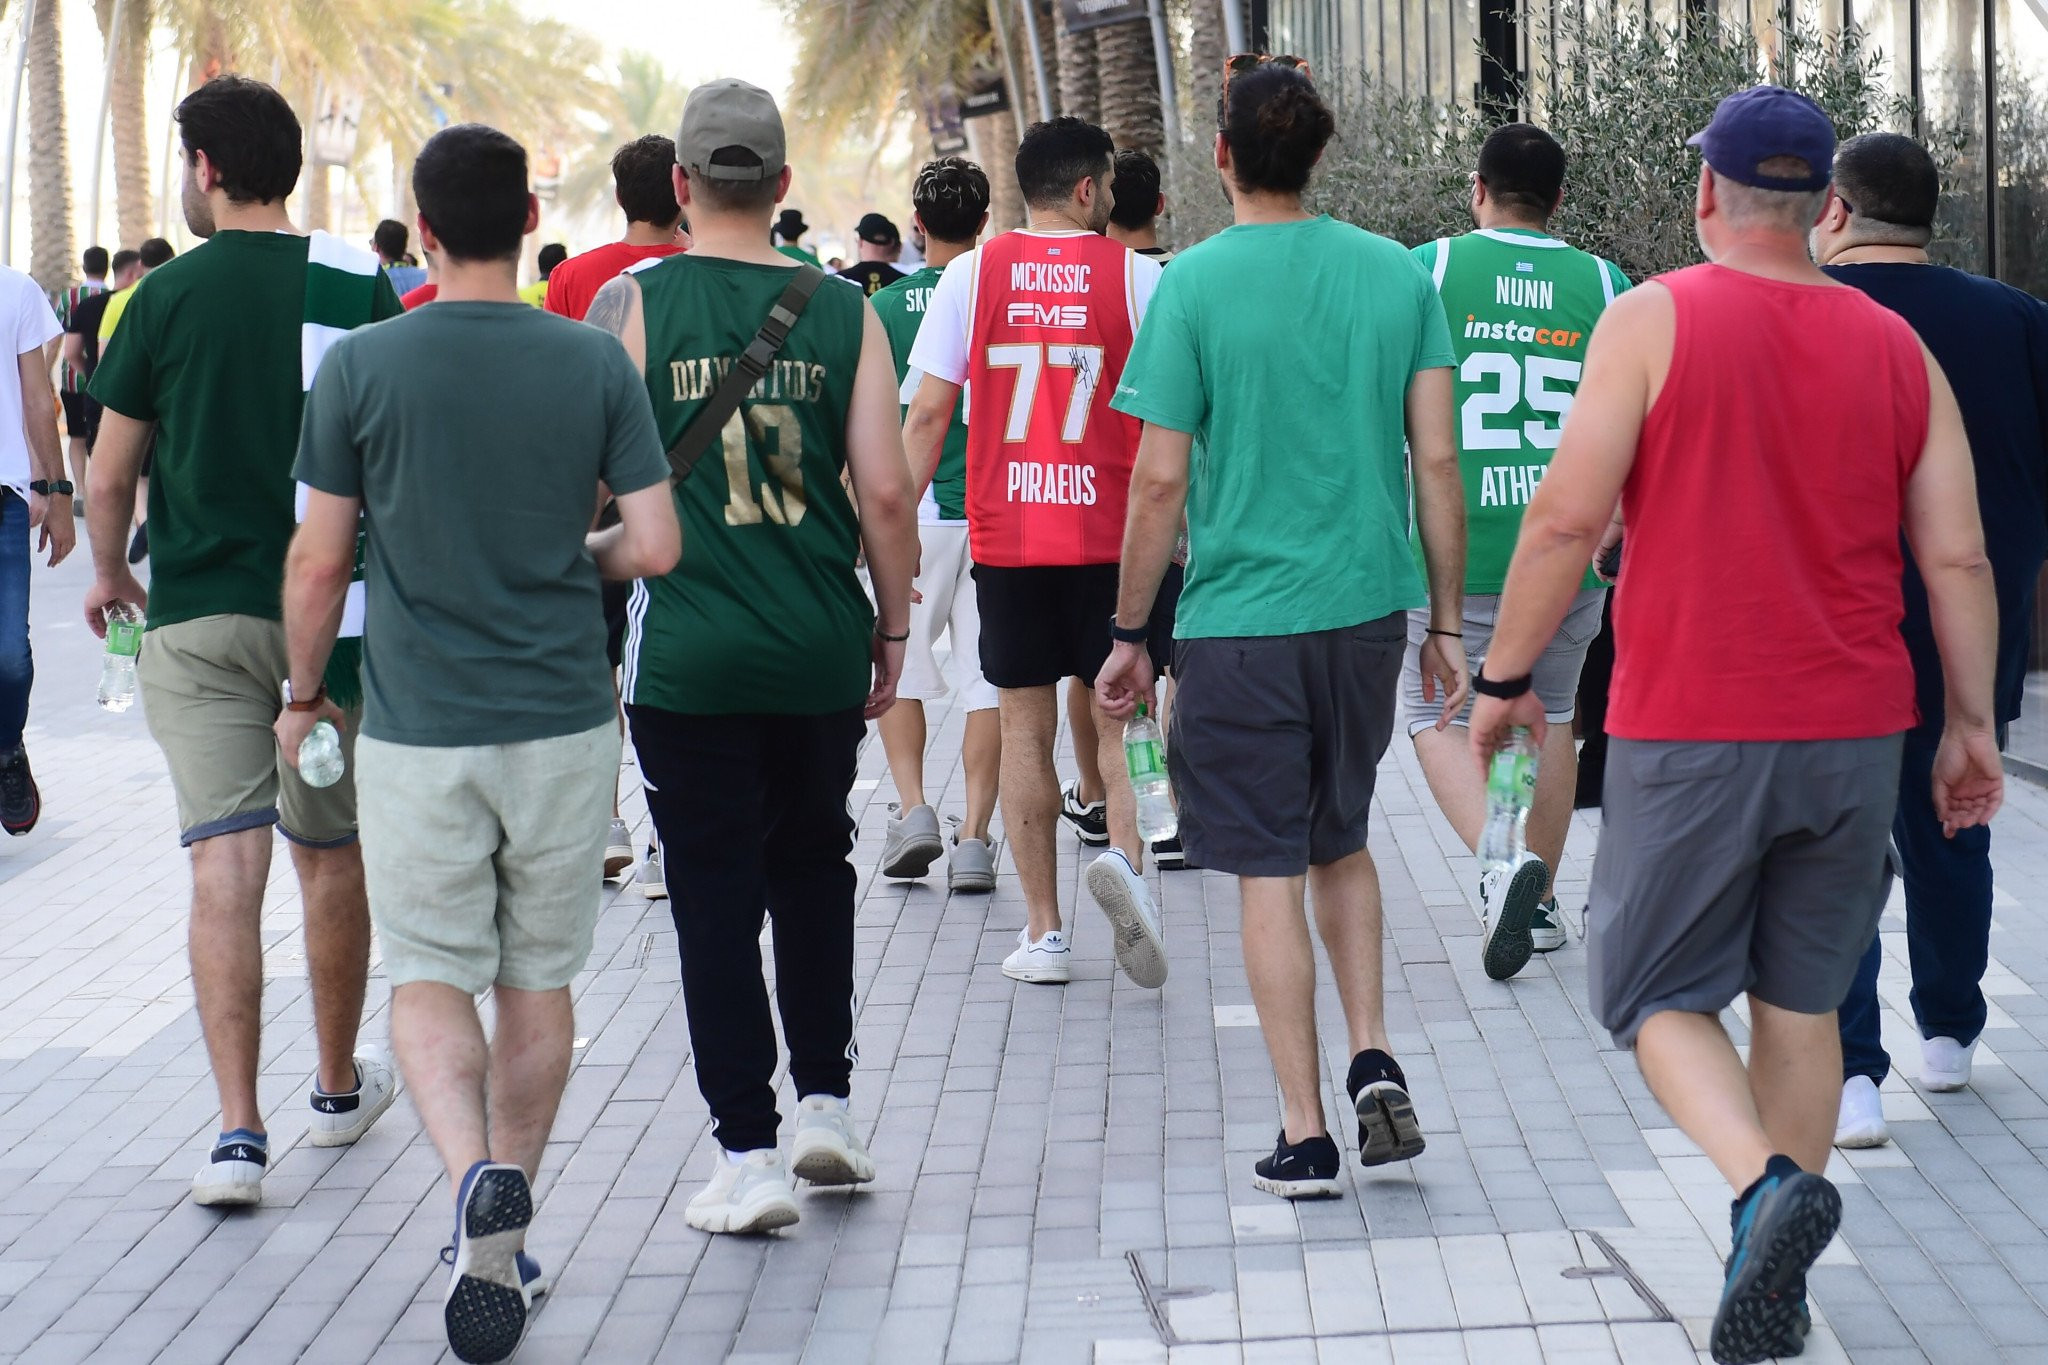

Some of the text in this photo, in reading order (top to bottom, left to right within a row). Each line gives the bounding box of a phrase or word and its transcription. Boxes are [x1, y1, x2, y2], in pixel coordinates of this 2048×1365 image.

[1011, 262, 1091, 294] MCKISSIC
[1496, 275, 1553, 310] NUNN
[1007, 302, 1088, 328] FMS
[1464, 314, 1581, 347] instacar
[985, 342, 1104, 444] 77
[1460, 352, 1582, 450] 25
[721, 404, 807, 527] 13
[1007, 461, 1097, 506] PIRAEUS
[1480, 465, 1550, 507] ATHE
